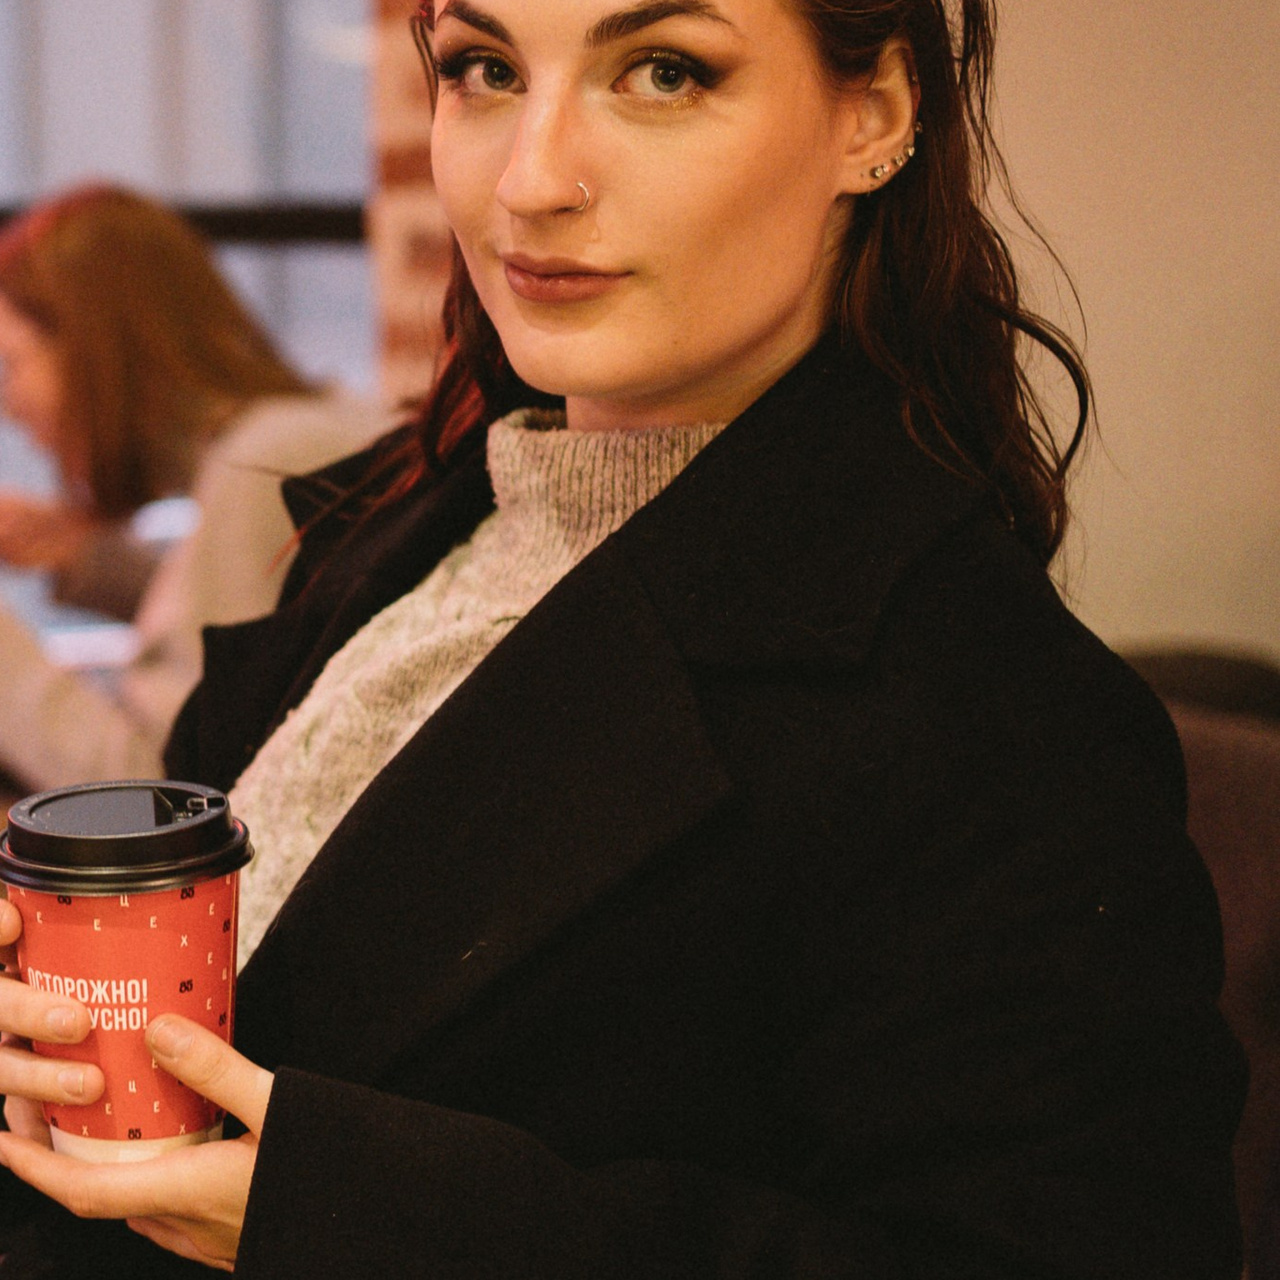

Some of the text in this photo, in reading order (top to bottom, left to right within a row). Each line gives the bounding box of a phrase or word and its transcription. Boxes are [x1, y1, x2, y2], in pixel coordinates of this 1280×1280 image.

[27, 966, 148, 1004] ОСТОРОЖНО!
[179, 978, 194, 994] 85
[87, 1006, 148, 1031] УСНО!
